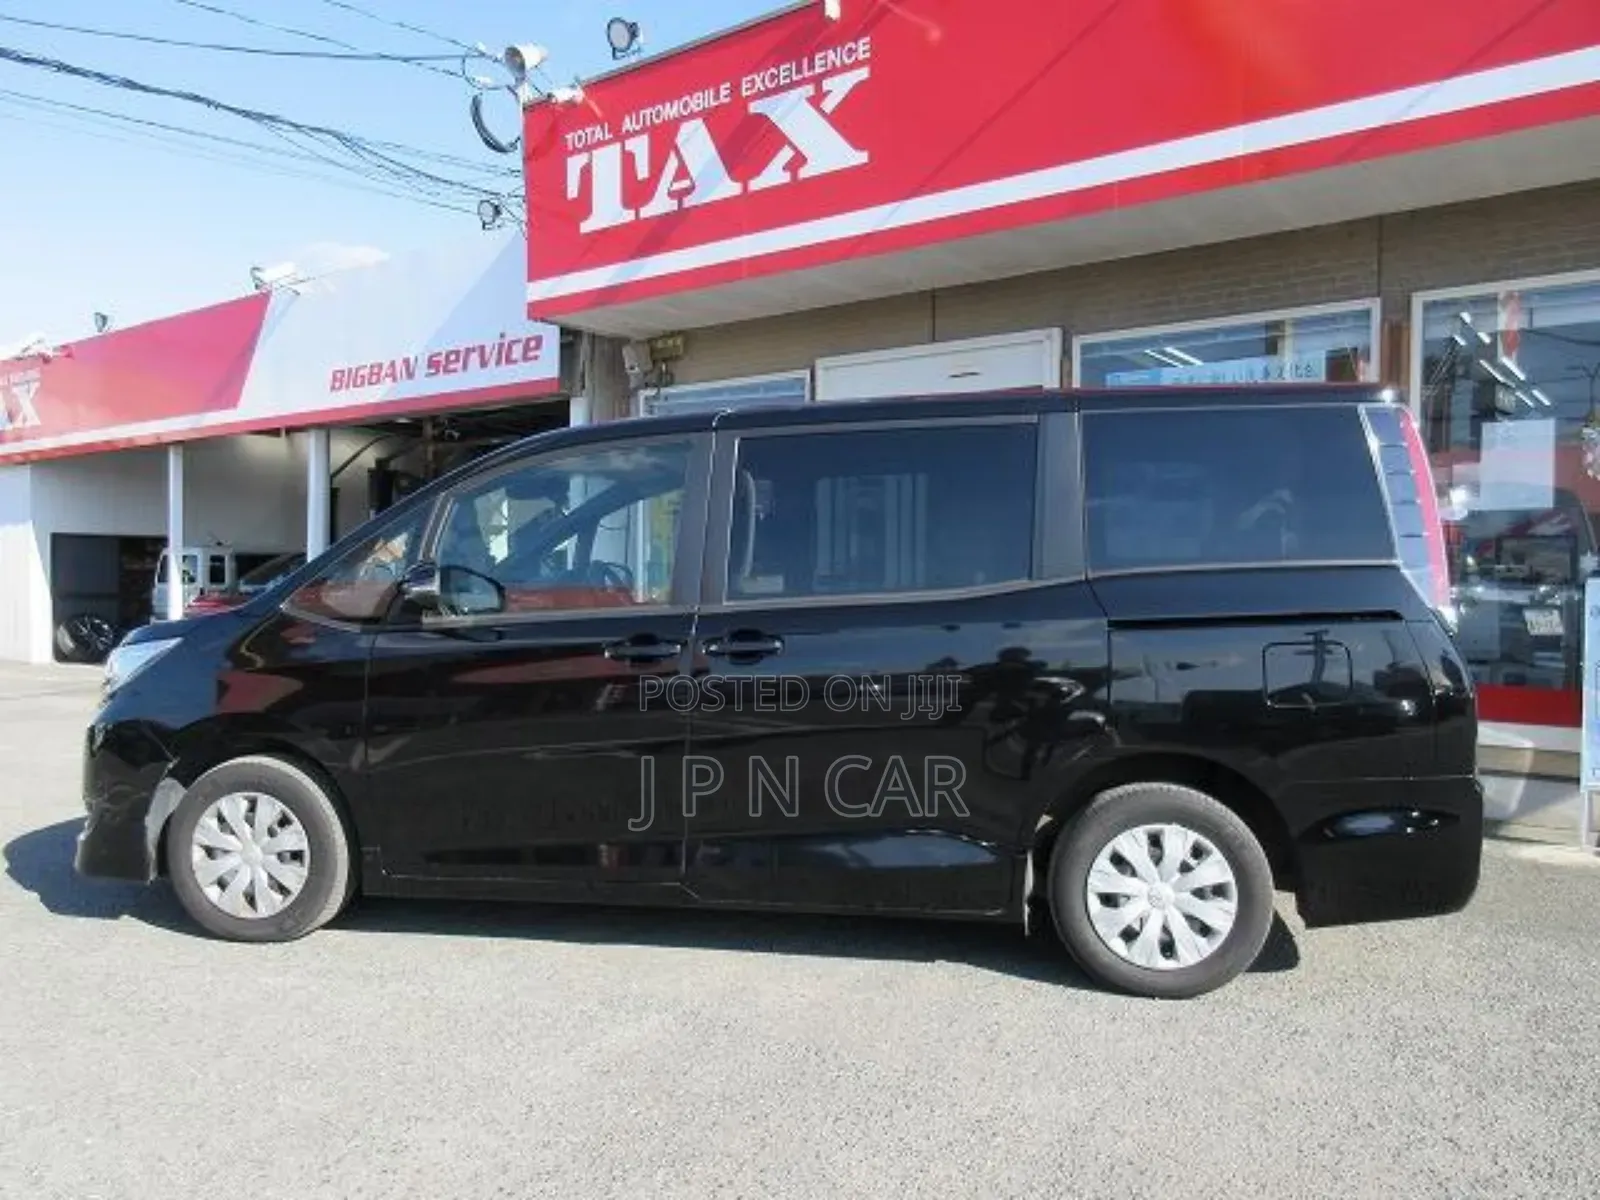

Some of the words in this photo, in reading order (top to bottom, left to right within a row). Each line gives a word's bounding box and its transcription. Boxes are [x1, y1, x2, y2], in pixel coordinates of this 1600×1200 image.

[565, 123, 613, 150] TOTAL
[621, 83, 731, 133] AUTOMOBILE
[741, 37, 871, 97] EXCELLENCE
[566, 67, 869, 234] TAX
[330, 355, 418, 392] BIGBAN
[424, 333, 543, 377] service
